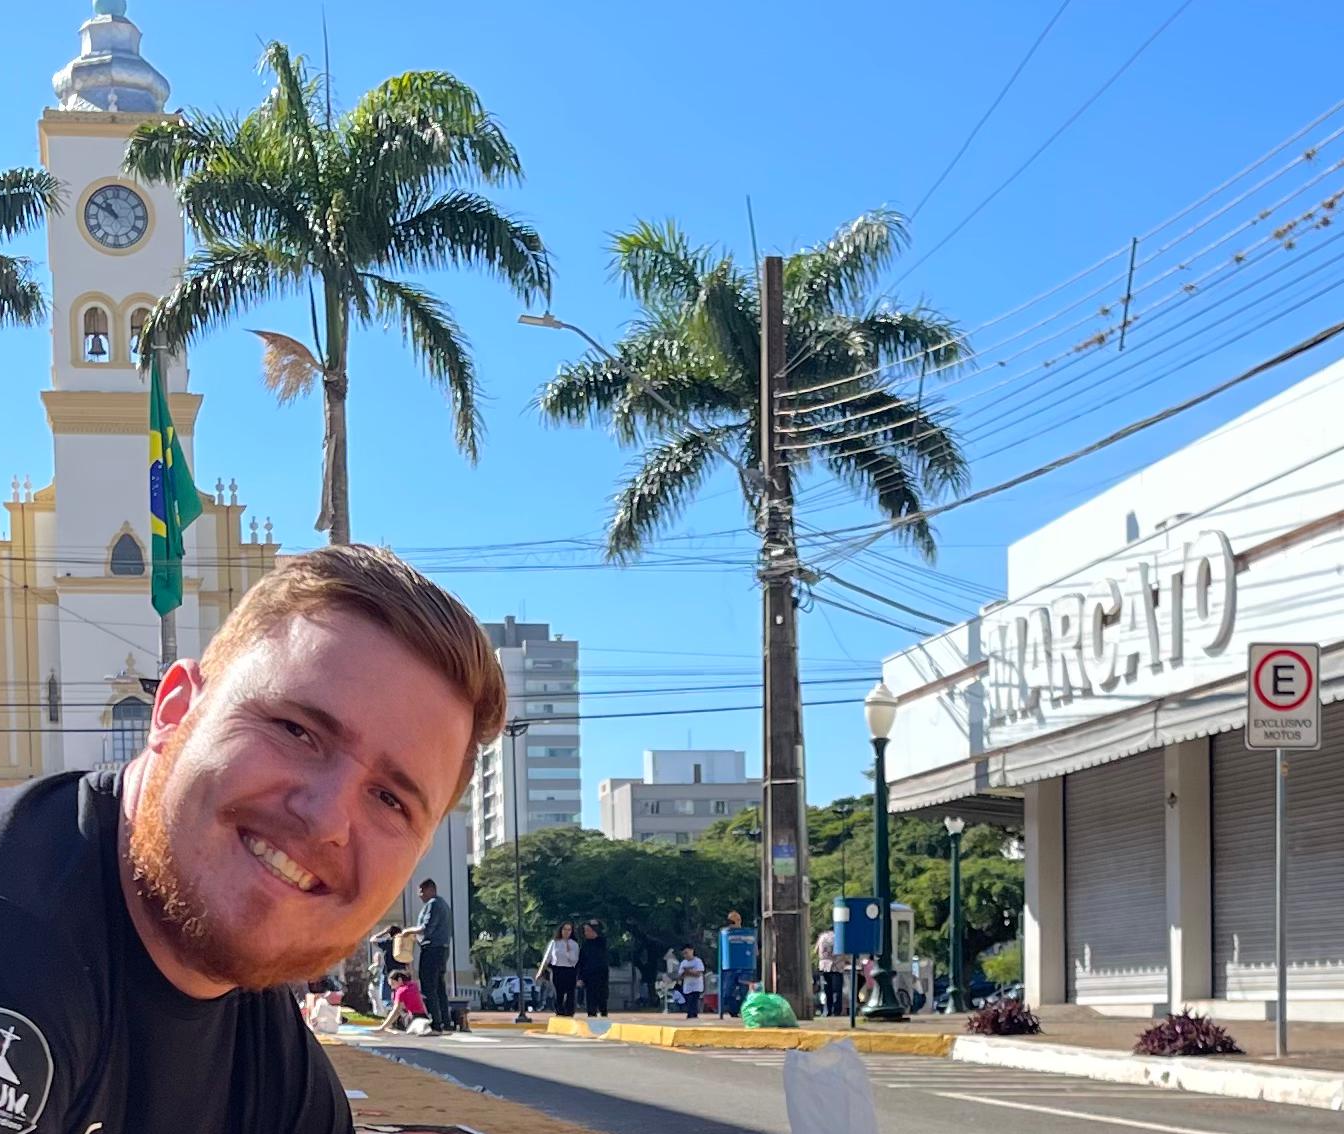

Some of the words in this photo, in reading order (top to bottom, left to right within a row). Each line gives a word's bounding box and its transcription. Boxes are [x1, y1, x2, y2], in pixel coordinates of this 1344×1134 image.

[989, 530, 1237, 727] MARCATO
[1272, 664, 1295, 696] E
[1253, 719, 1312, 729] EXCLUSIVO
[1263, 731, 1302, 741] MOTOS
